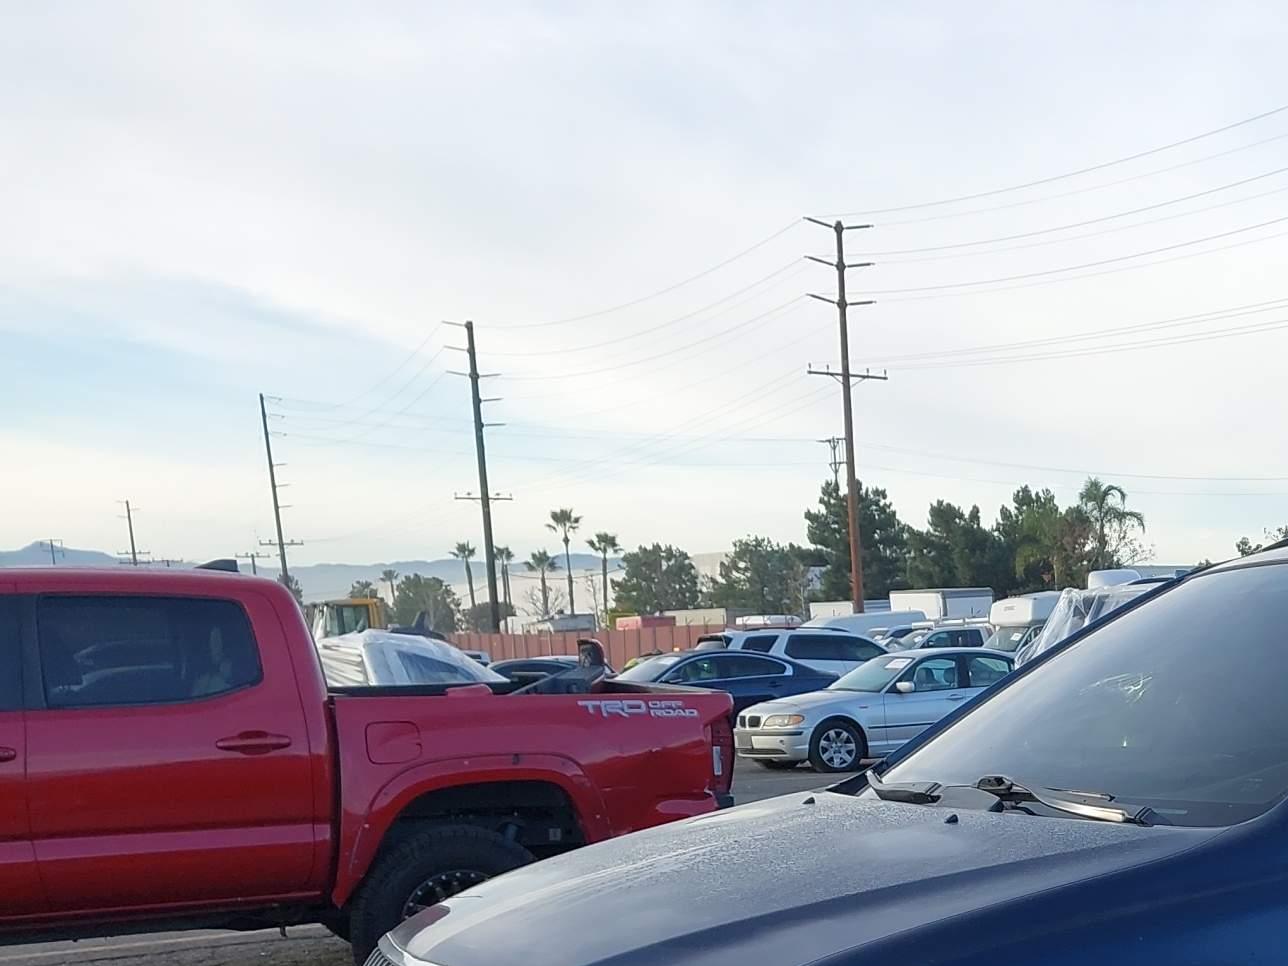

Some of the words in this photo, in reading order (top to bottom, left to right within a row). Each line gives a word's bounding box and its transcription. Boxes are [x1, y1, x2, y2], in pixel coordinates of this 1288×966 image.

[648, 700, 683, 708] OFF
[577, 700, 648, 718] TRD
[650, 708, 699, 717] ROAD
